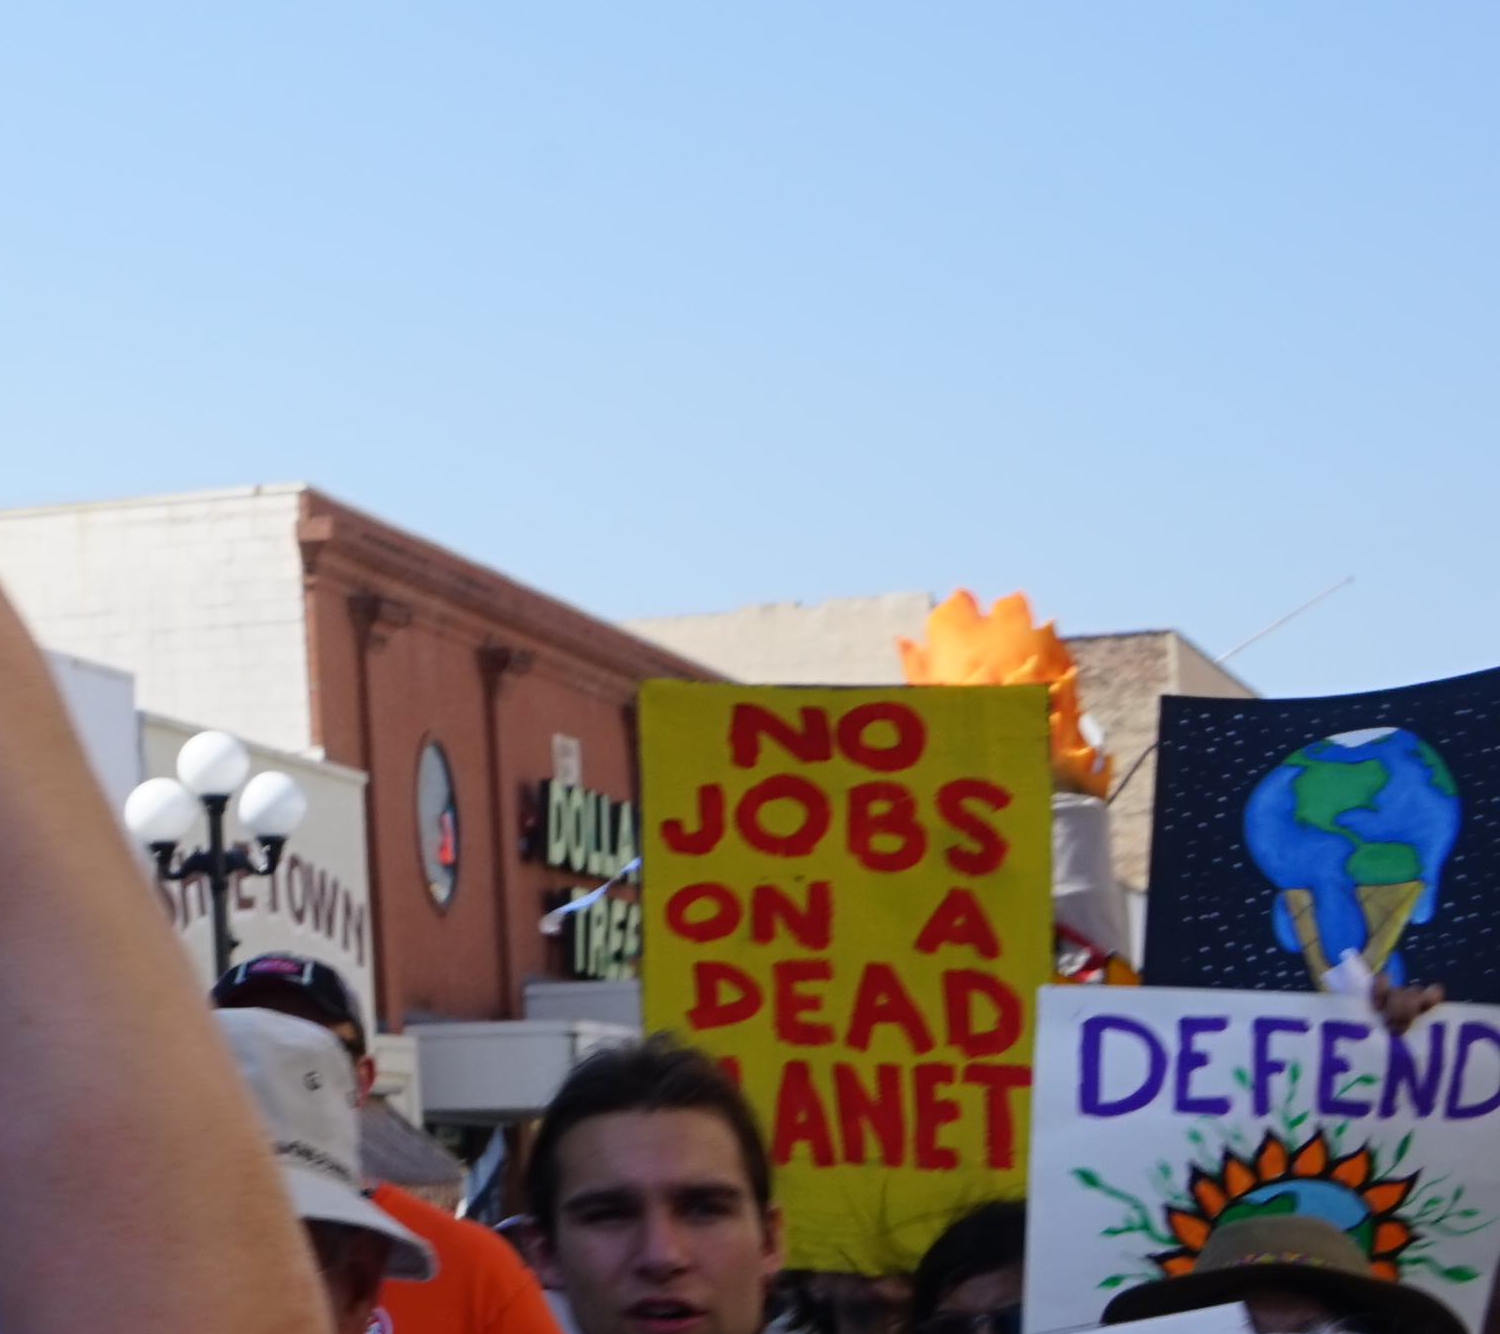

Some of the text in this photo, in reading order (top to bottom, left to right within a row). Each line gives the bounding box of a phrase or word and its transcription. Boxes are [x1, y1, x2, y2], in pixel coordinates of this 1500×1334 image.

[729, 701, 928, 772] NO
[660, 773, 1013, 877] JOBS
[665, 880, 1000, 960] ON A
[686, 959, 1023, 1059] DEAD
[718, 1056, 1031, 1171] ANET
[1077, 1014, 1500, 1120] DEFEND
